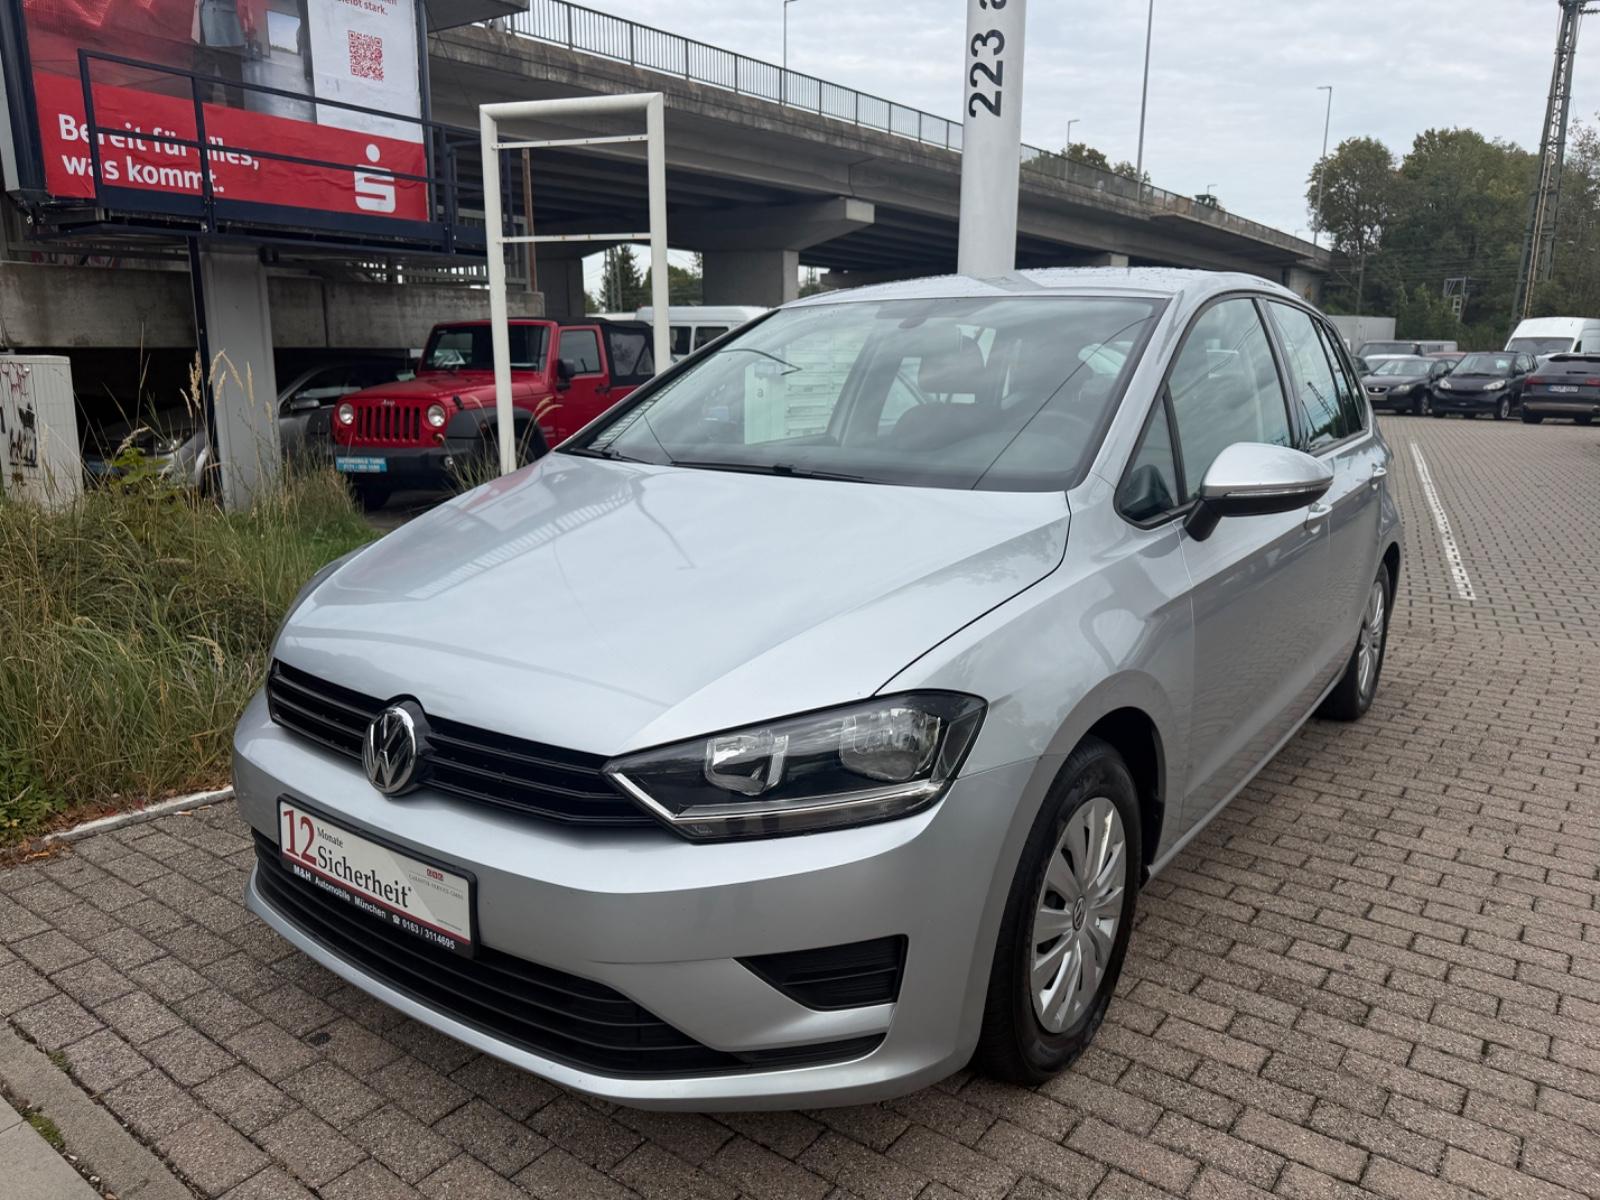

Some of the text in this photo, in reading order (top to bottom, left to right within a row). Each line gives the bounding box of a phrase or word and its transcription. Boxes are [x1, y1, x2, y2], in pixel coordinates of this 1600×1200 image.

[968, 29, 1005, 118] 223
[198, 136, 259, 170] lles,
[283, 809, 344, 867] 12 Monate
[293, 864, 312, 881] M&H
[314, 876, 351, 902] Automobile
[354, 895, 387, 919] München
